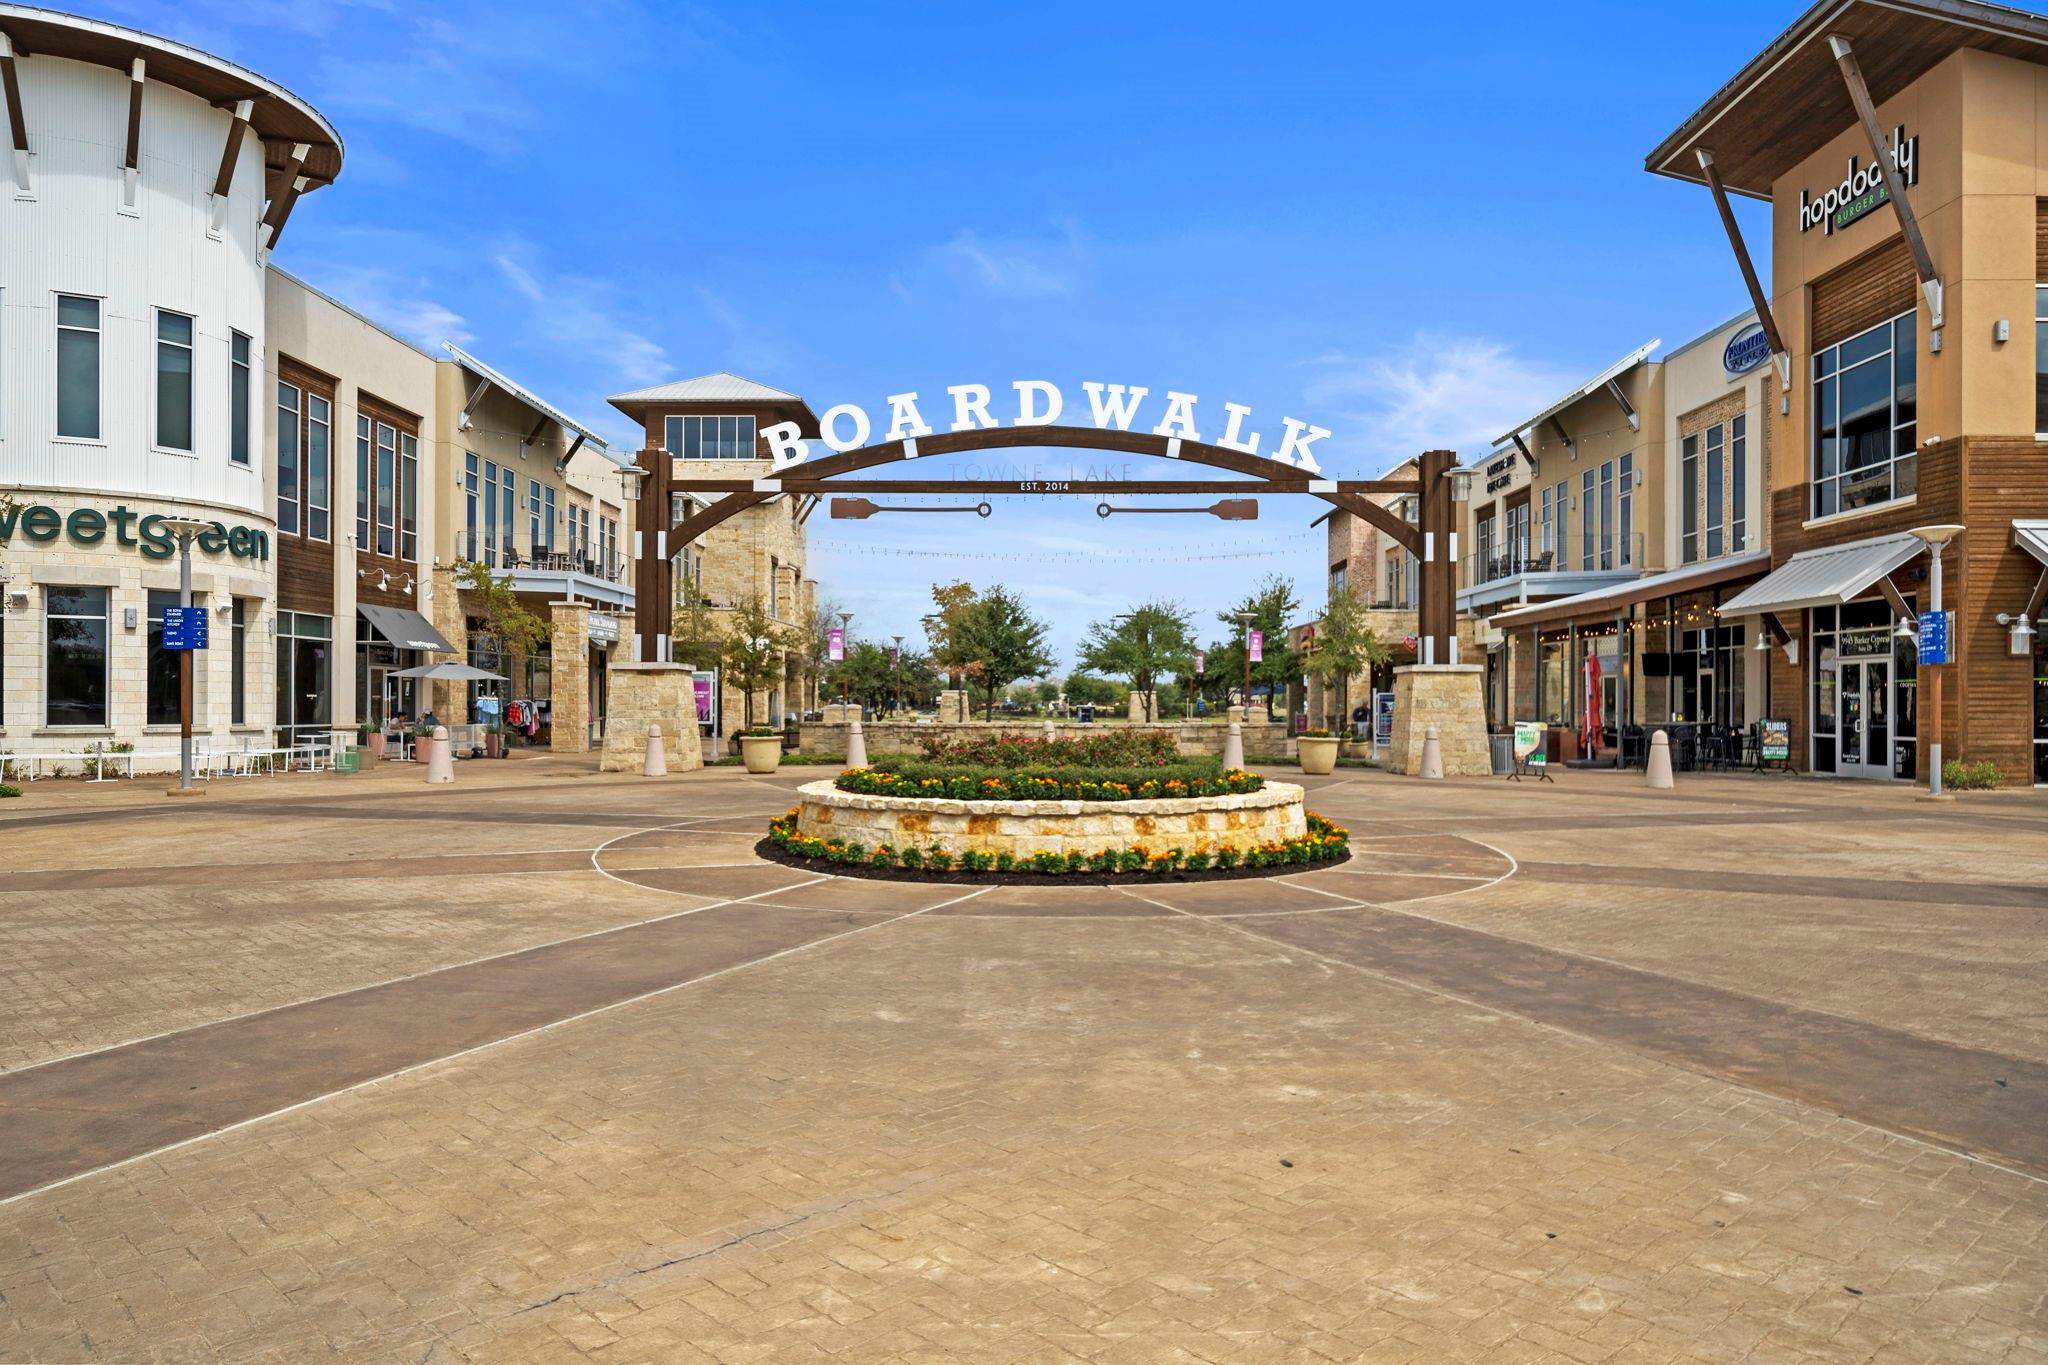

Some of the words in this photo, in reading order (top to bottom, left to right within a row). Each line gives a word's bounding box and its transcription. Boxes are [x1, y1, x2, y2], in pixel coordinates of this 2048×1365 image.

[1837, 195, 1875, 224] BURGER
[1728, 331, 1768, 360] FRONTIE
[759, 380, 1332, 474] BOARDWALK
[947, 463, 1043, 482] TOWNE
[1070, 463, 1133, 482] LAKE
[1020, 482, 1041, 491] EST.
[1045, 482, 1069, 491] 2014
[0, 505, 269, 561] eetgeen
[1854, 635, 1870, 645] Barker
[1871, 634, 1890, 646] Cypress
[1766, 722, 1787, 731] SLIDERS
